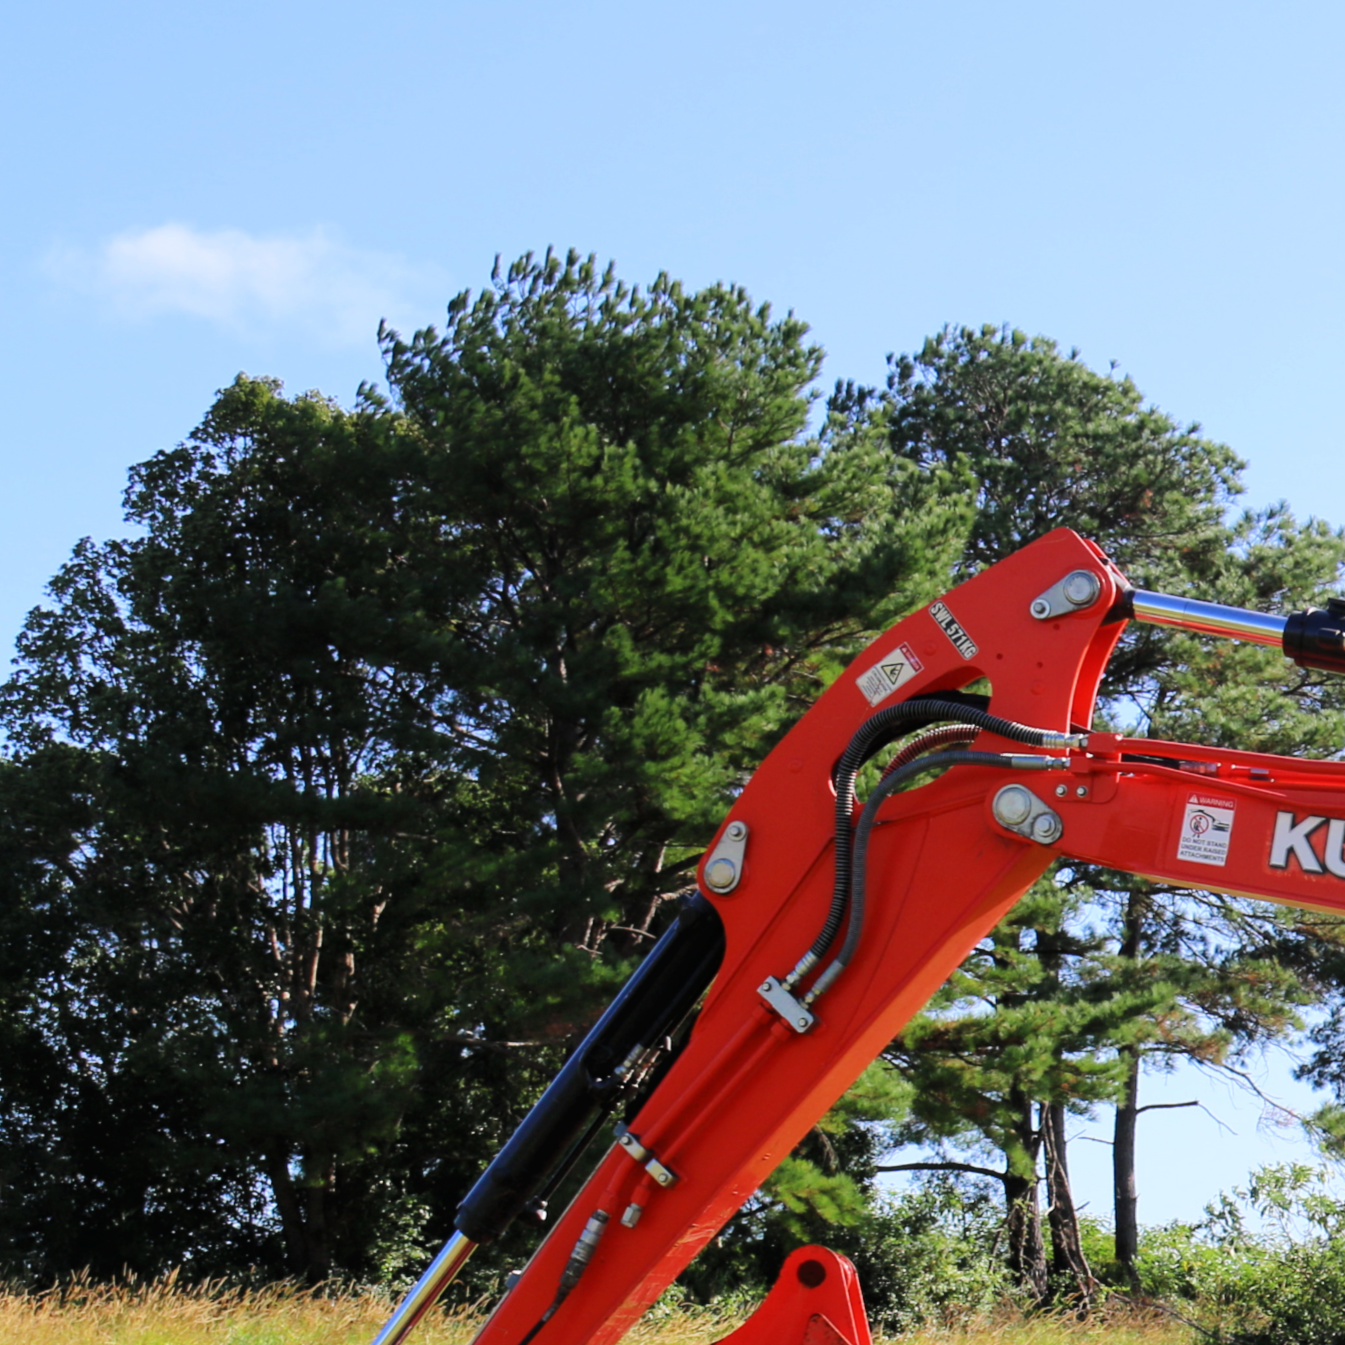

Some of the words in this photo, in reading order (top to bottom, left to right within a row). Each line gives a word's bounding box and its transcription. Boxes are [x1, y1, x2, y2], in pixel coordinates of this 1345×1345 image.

[929, 602, 955, 629] SWL
[945, 623, 978, 659] 571KG
[1200, 797, 1233, 808] WARNING
[1180, 851, 1224, 861] ATTACHMENTS
